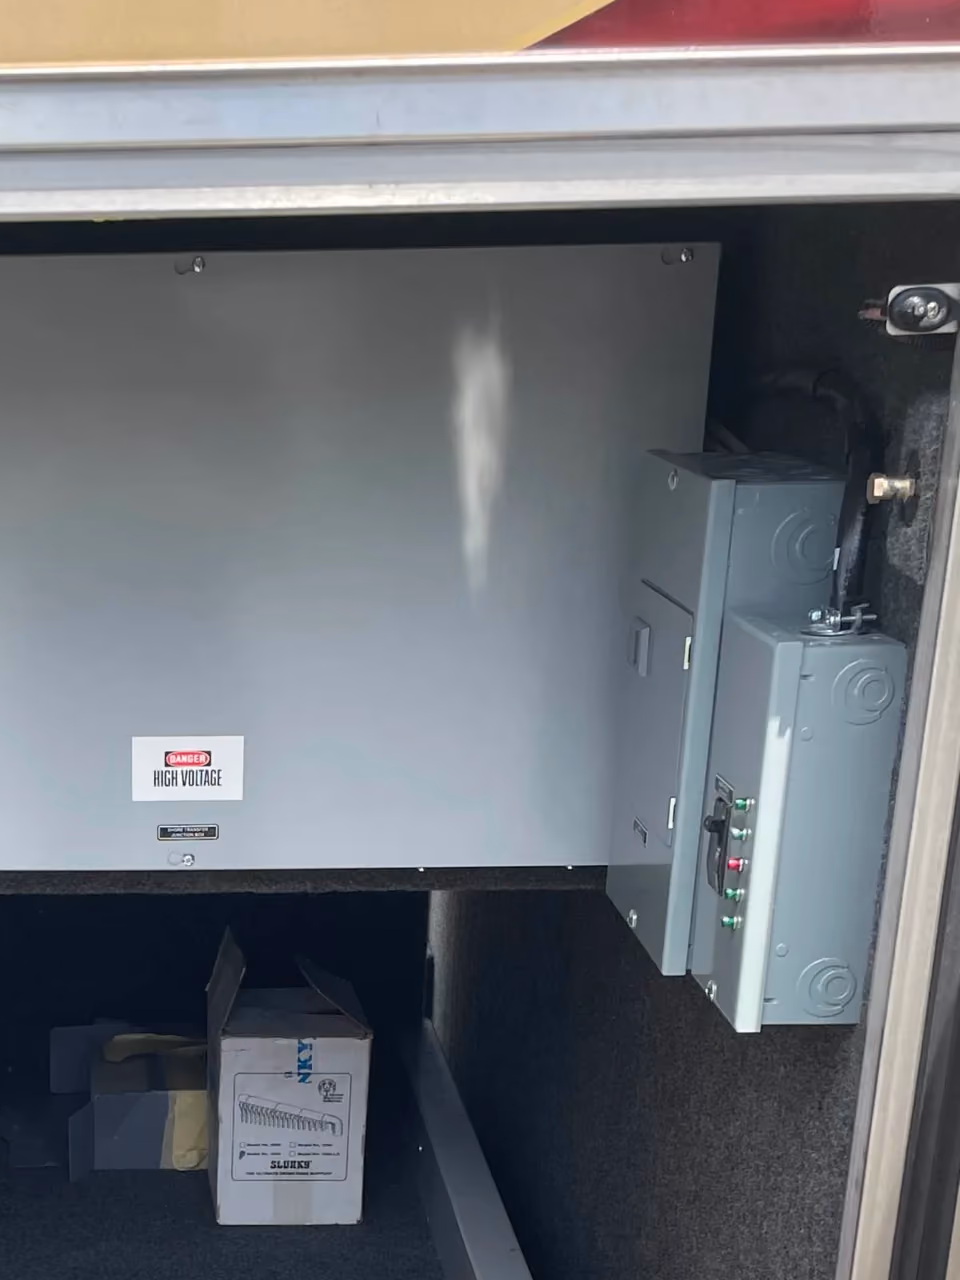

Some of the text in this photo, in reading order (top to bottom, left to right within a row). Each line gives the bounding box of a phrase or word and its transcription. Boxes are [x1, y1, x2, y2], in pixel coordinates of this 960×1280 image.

[169, 754, 206, 764] DANGER
[153, 768, 222, 787] HIGH VOLTAGE
